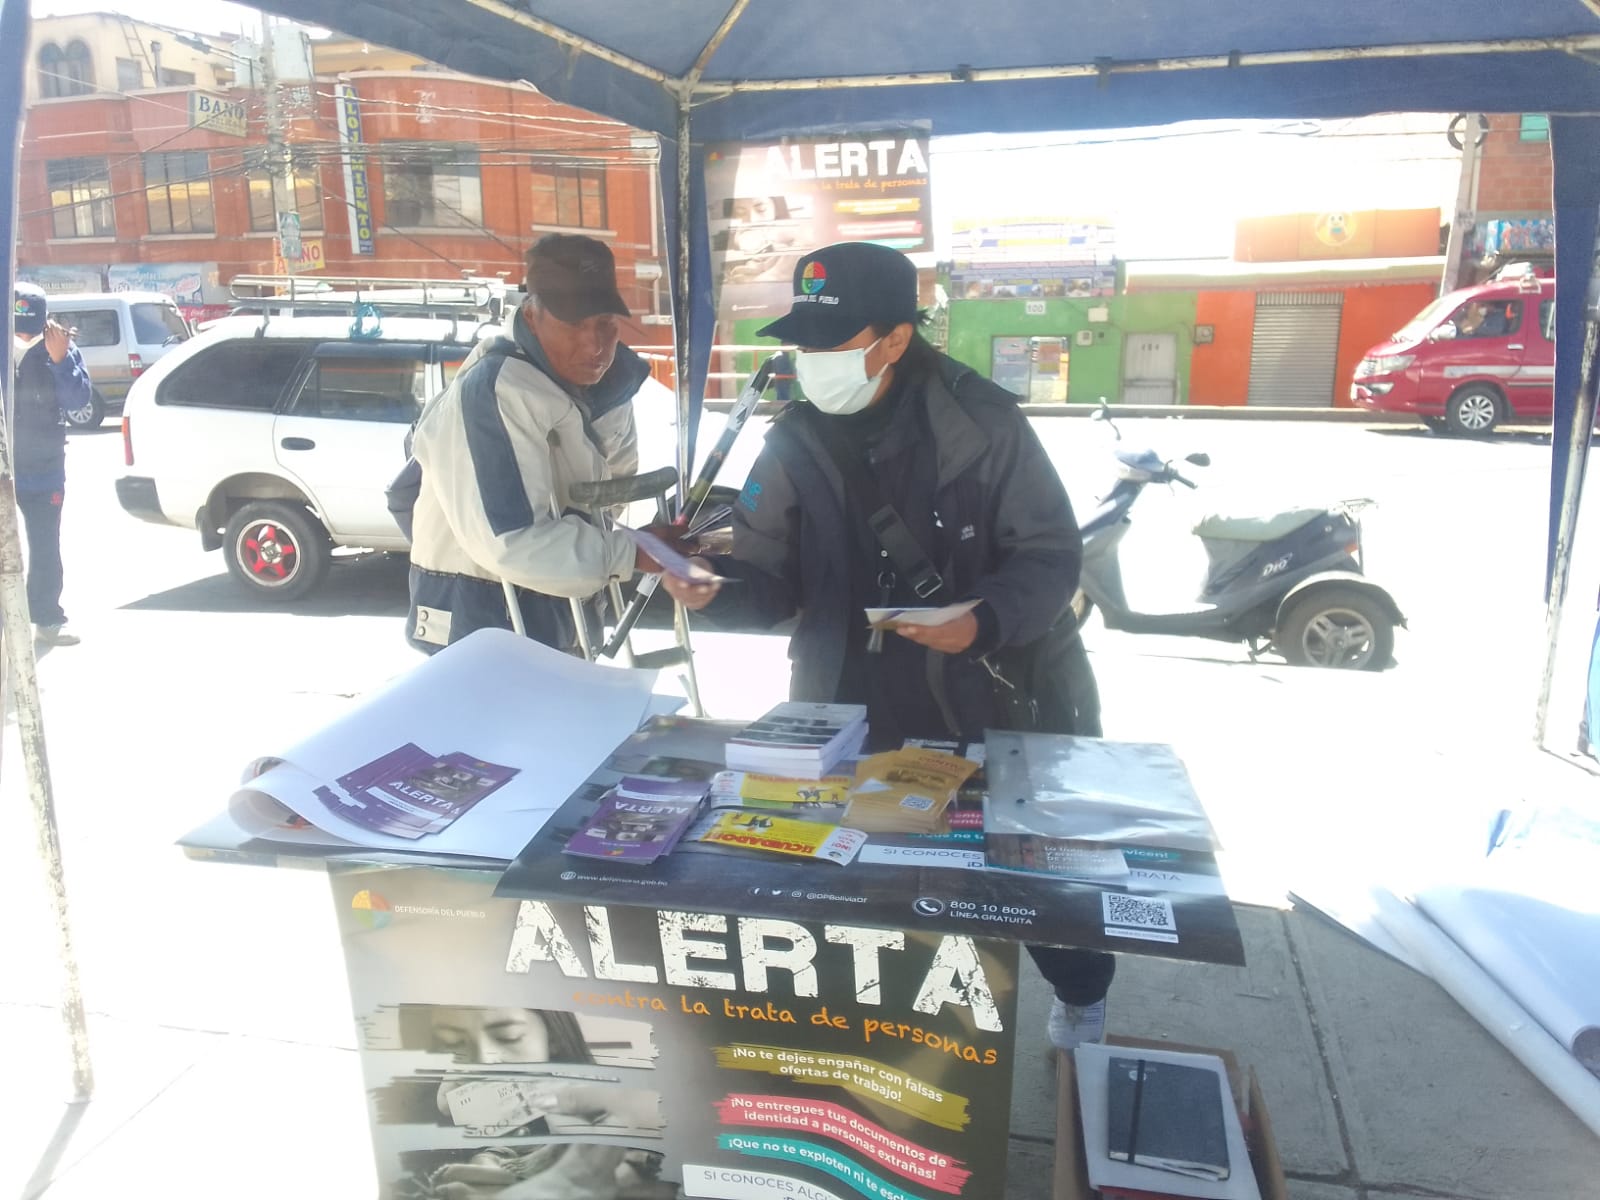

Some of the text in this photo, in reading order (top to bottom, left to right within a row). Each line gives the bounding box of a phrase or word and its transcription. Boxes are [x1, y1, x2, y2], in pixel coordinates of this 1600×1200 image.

[766, 138, 929, 180] ALERTA
[388, 781, 455, 810] ALERTA
[615, 801, 690, 815] ALERTA
[882, 847, 983, 861] SI CONOCES
[440, 908, 456, 917] DEL
[456, 909, 486, 919] PUEBLO
[949, 900, 1037, 917] 800 10 8004
[949, 909, 1033, 926] LÍNEA GRATUITA
[505, 899, 1004, 1033] ALERTA
[572, 988, 999, 1067] contra la trata de personas
[732, 1047, 944, 1103] ¡No te dejes engañar con falsas
[779, 1064, 902, 1103] ofertas de trabajo!
[731, 1097, 948, 1169] ¡No entregues tus documentos de
[743, 1109, 937, 1181] identidad a personas extrañas!
[703, 1170, 717, 1181] SI
[720, 1172, 794, 1193] CONOCES
[727, 1136, 760, 1151] ¡Que
[762, 1141, 781, 1152] no
[782, 1142, 797, 1154] te
[798, 1146, 852, 1176] exploten
[853, 1170, 865, 1184] ni
[865, 1177, 879, 1192] te
